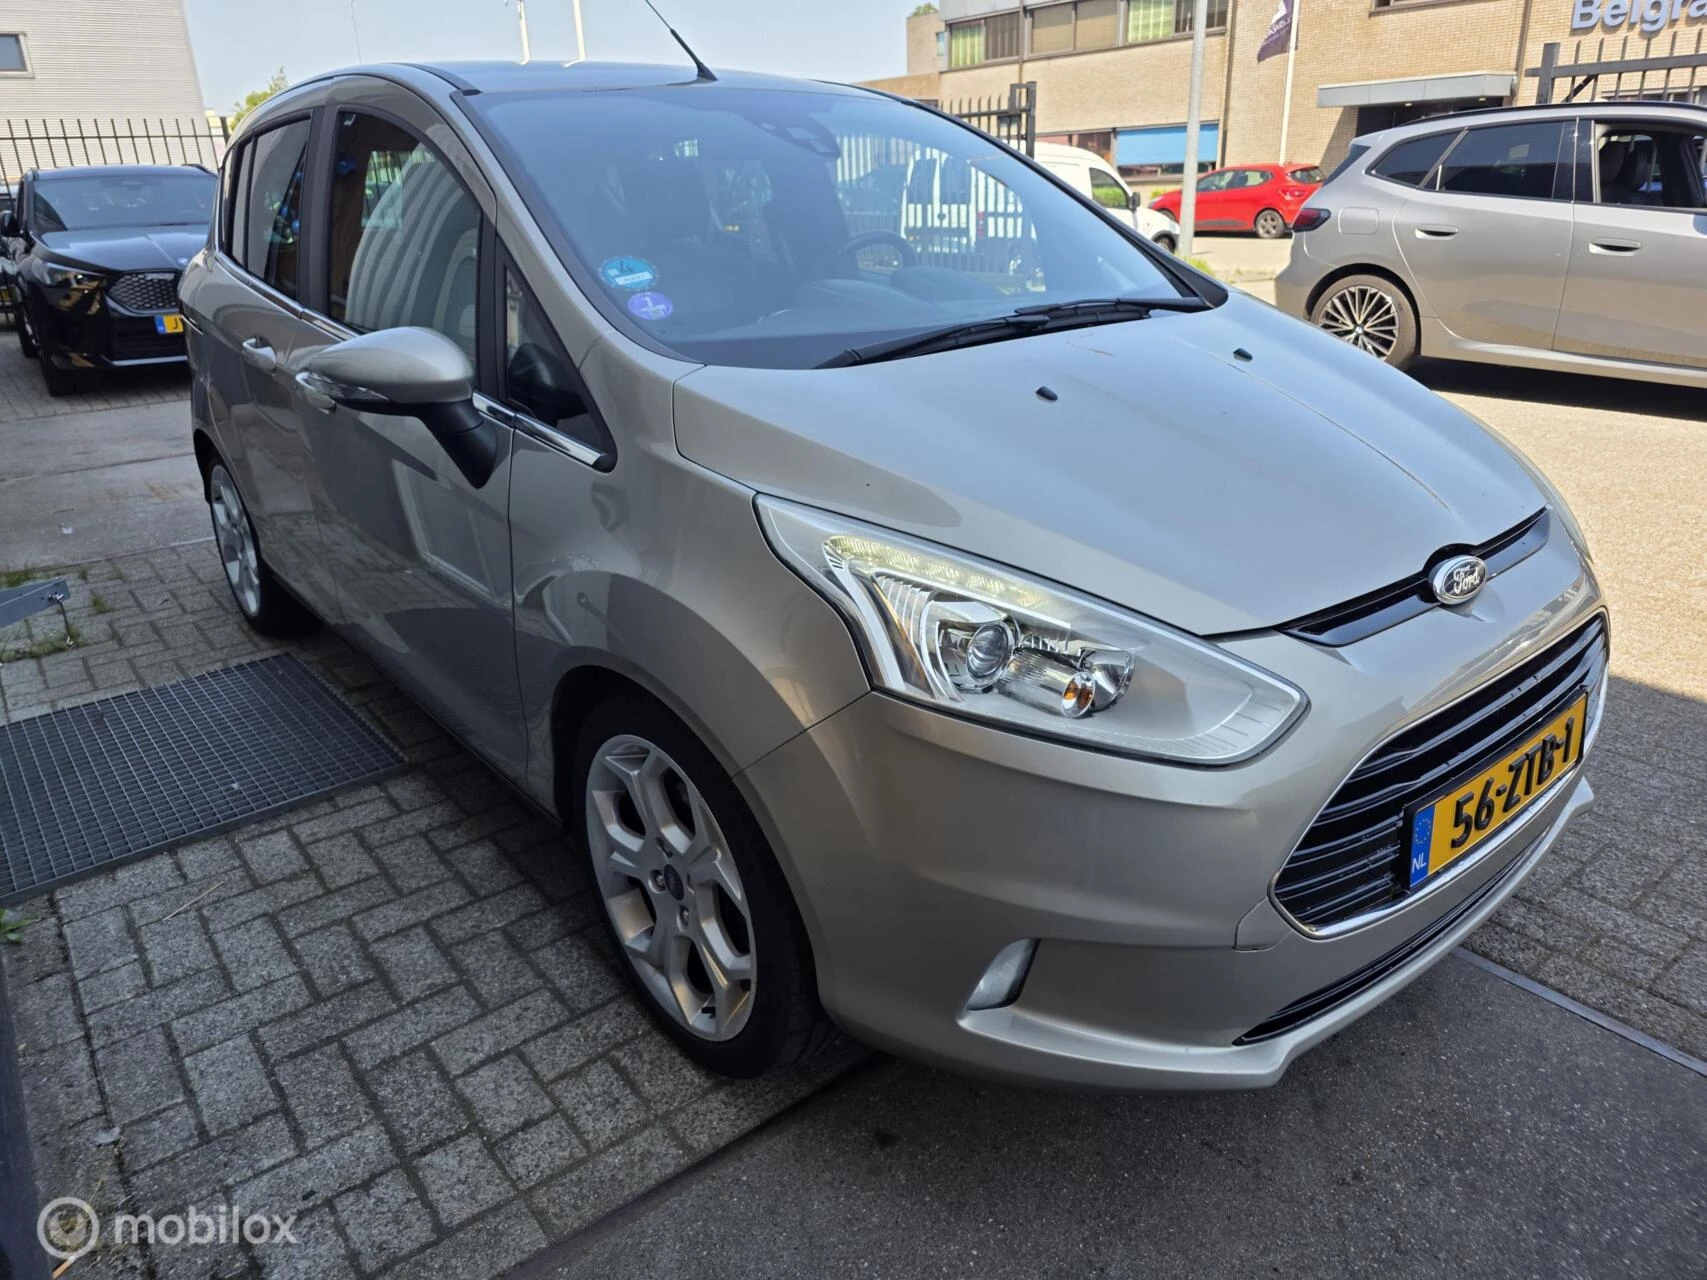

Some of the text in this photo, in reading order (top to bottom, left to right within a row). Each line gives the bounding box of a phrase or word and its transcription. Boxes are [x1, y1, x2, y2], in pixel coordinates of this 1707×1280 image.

[1453, 564, 1479, 594] Ford
[1450, 717, 1575, 849] 56-ZTB-1
[1411, 853, 1427, 873] NL
